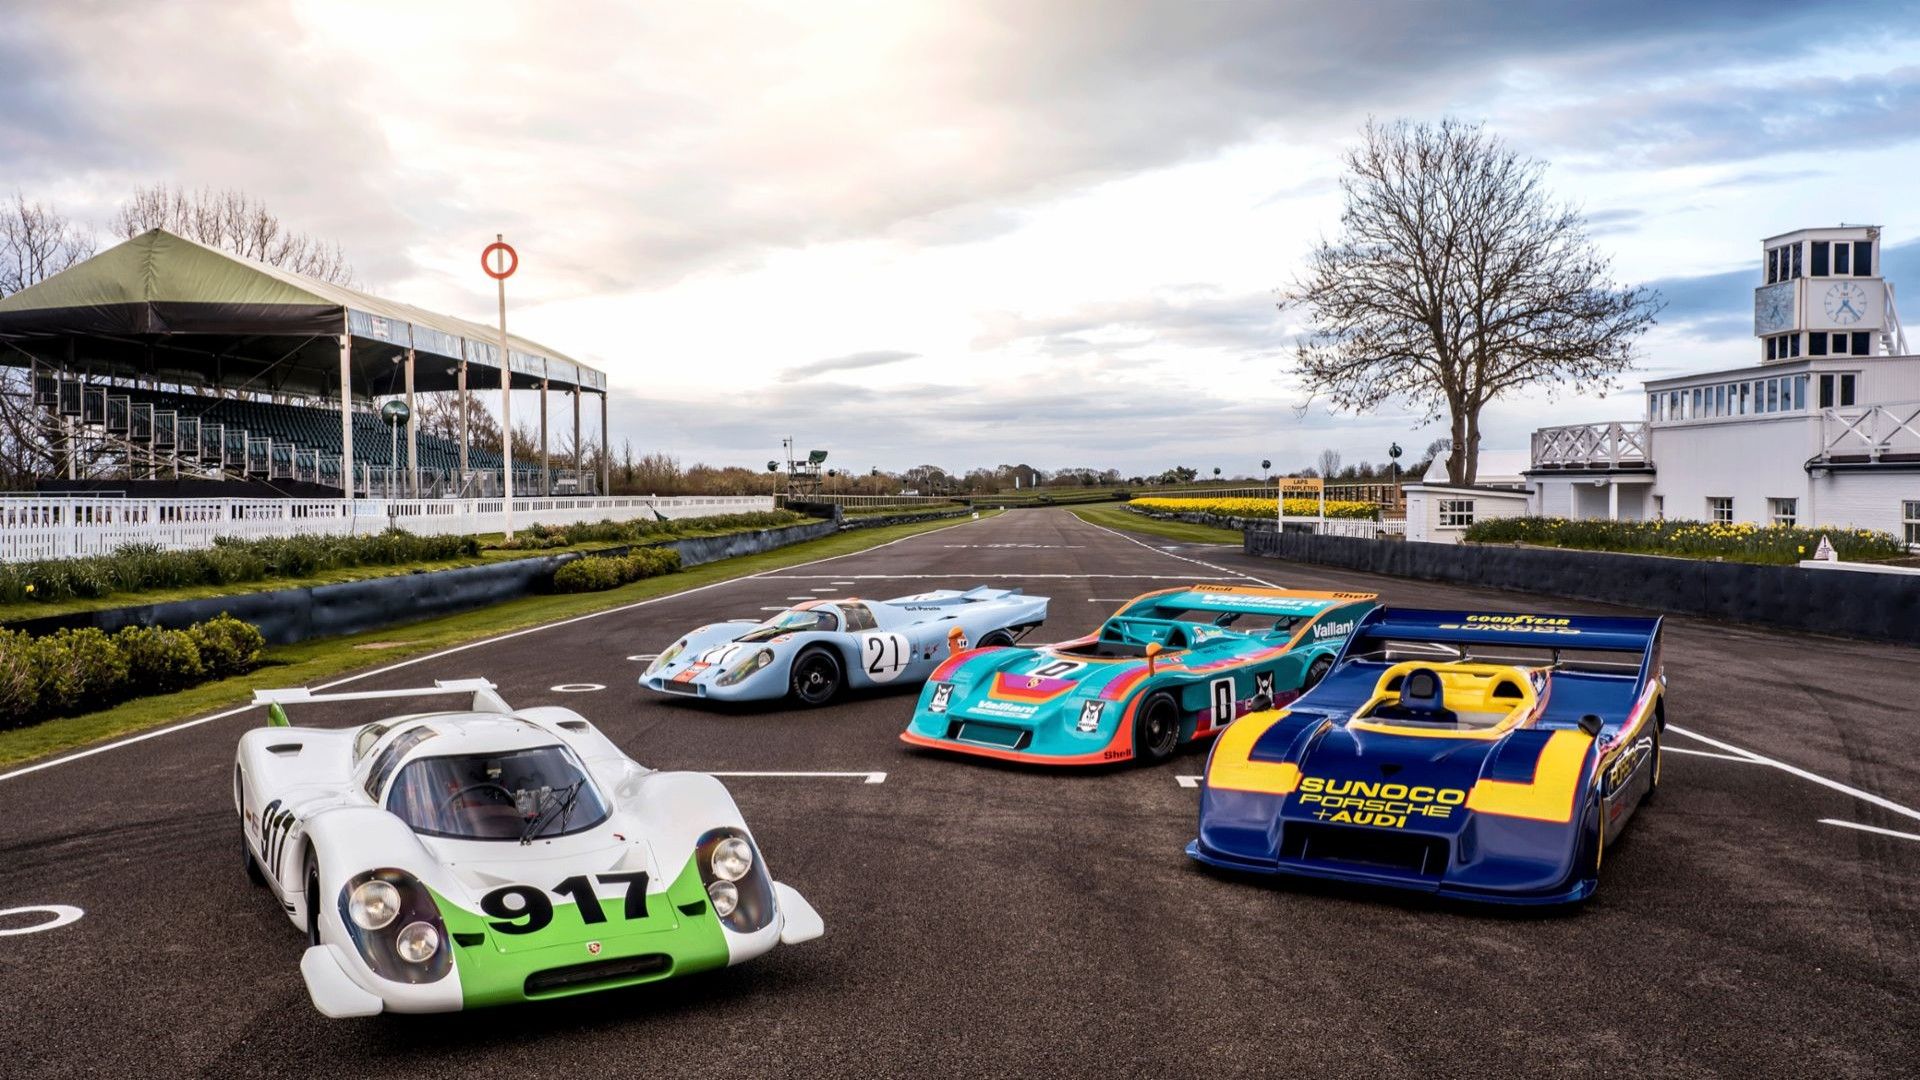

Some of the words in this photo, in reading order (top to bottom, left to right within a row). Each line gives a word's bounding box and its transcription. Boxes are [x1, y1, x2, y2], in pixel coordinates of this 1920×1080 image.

[1313, 620, 1353, 638] Vaillant
[1466, 615, 1570, 625] GOODYEAR
[868, 635, 899, 674] 21
[1035, 661, 1079, 676] 0
[1215, 680, 1232, 726] 0
[1104, 748, 1131, 759] Shell
[1300, 777, 1465, 805] SUNOCO
[1299, 793, 1452, 818] PORSCHE
[262, 799, 296, 882] 917
[481, 871, 649, 935] 917
